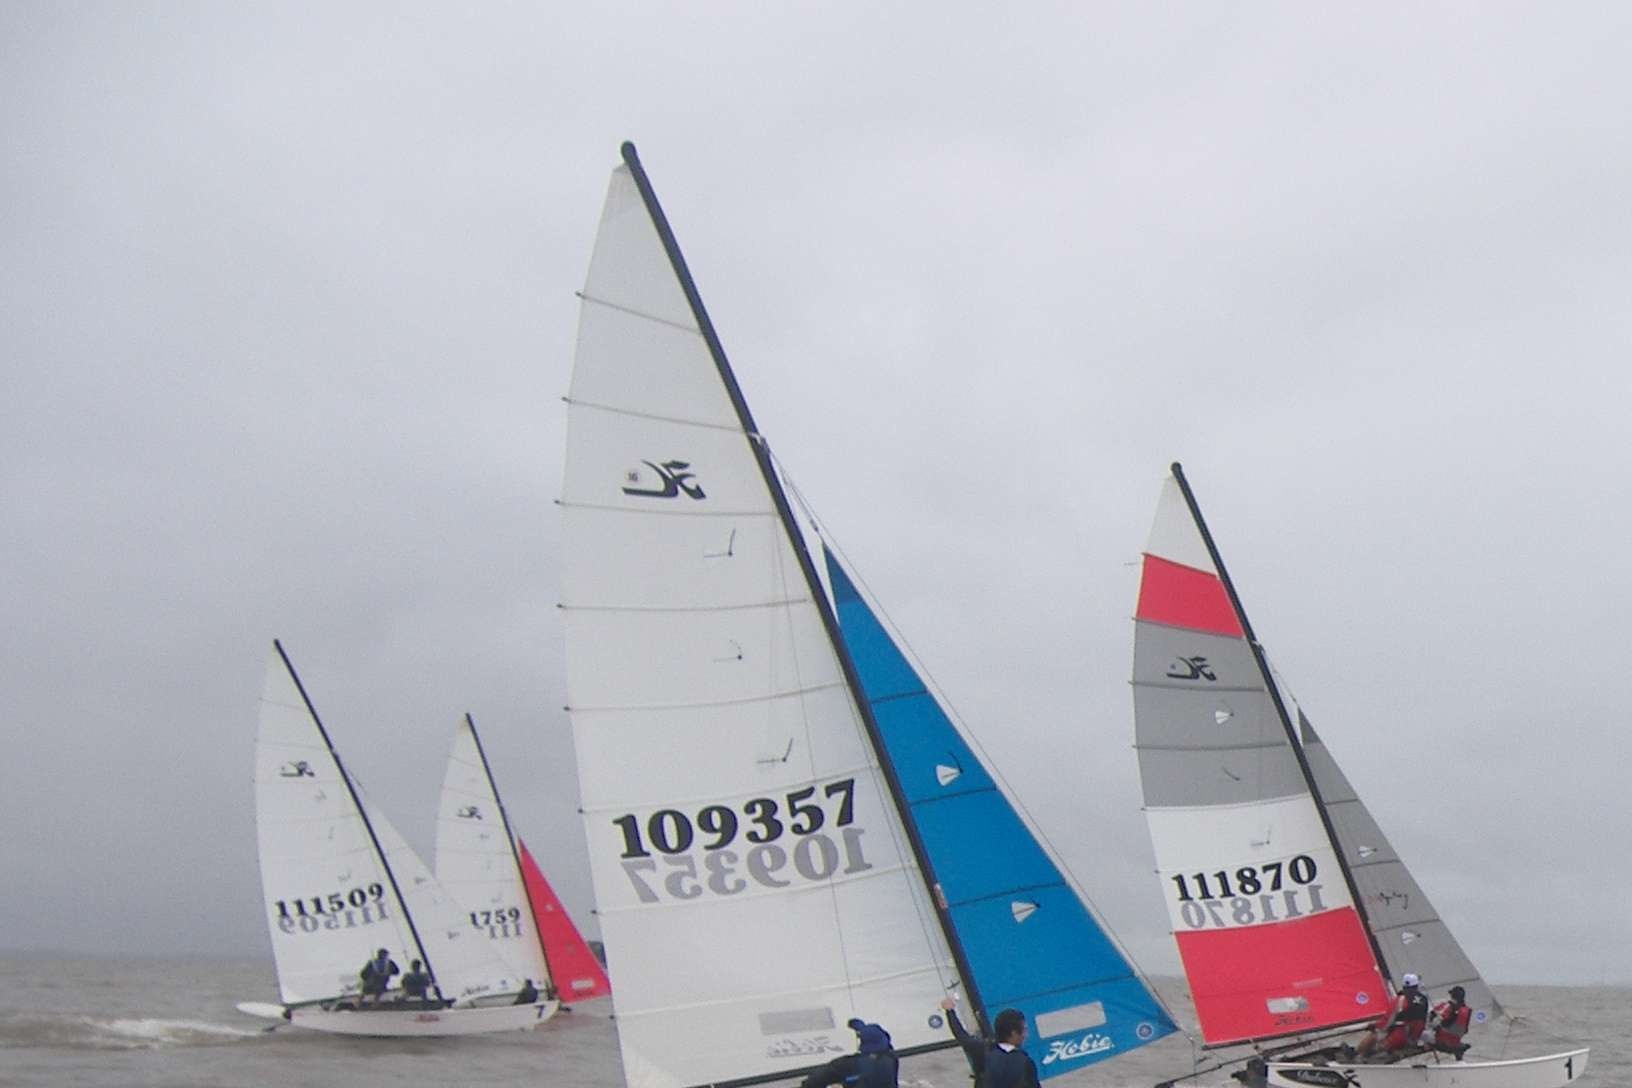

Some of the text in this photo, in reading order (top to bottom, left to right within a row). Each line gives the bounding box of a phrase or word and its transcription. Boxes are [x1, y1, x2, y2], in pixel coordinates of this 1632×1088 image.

[612, 778, 855, 859] 109357
[1171, 854, 1318, 901] 111870
[275, 883, 384, 918] 111509
[470, 906, 521, 929] 1759
[534, 1004, 547, 1018] 7
[1042, 1033, 1113, 1065] Hobie
[1564, 1056, 1573, 1080] 1
